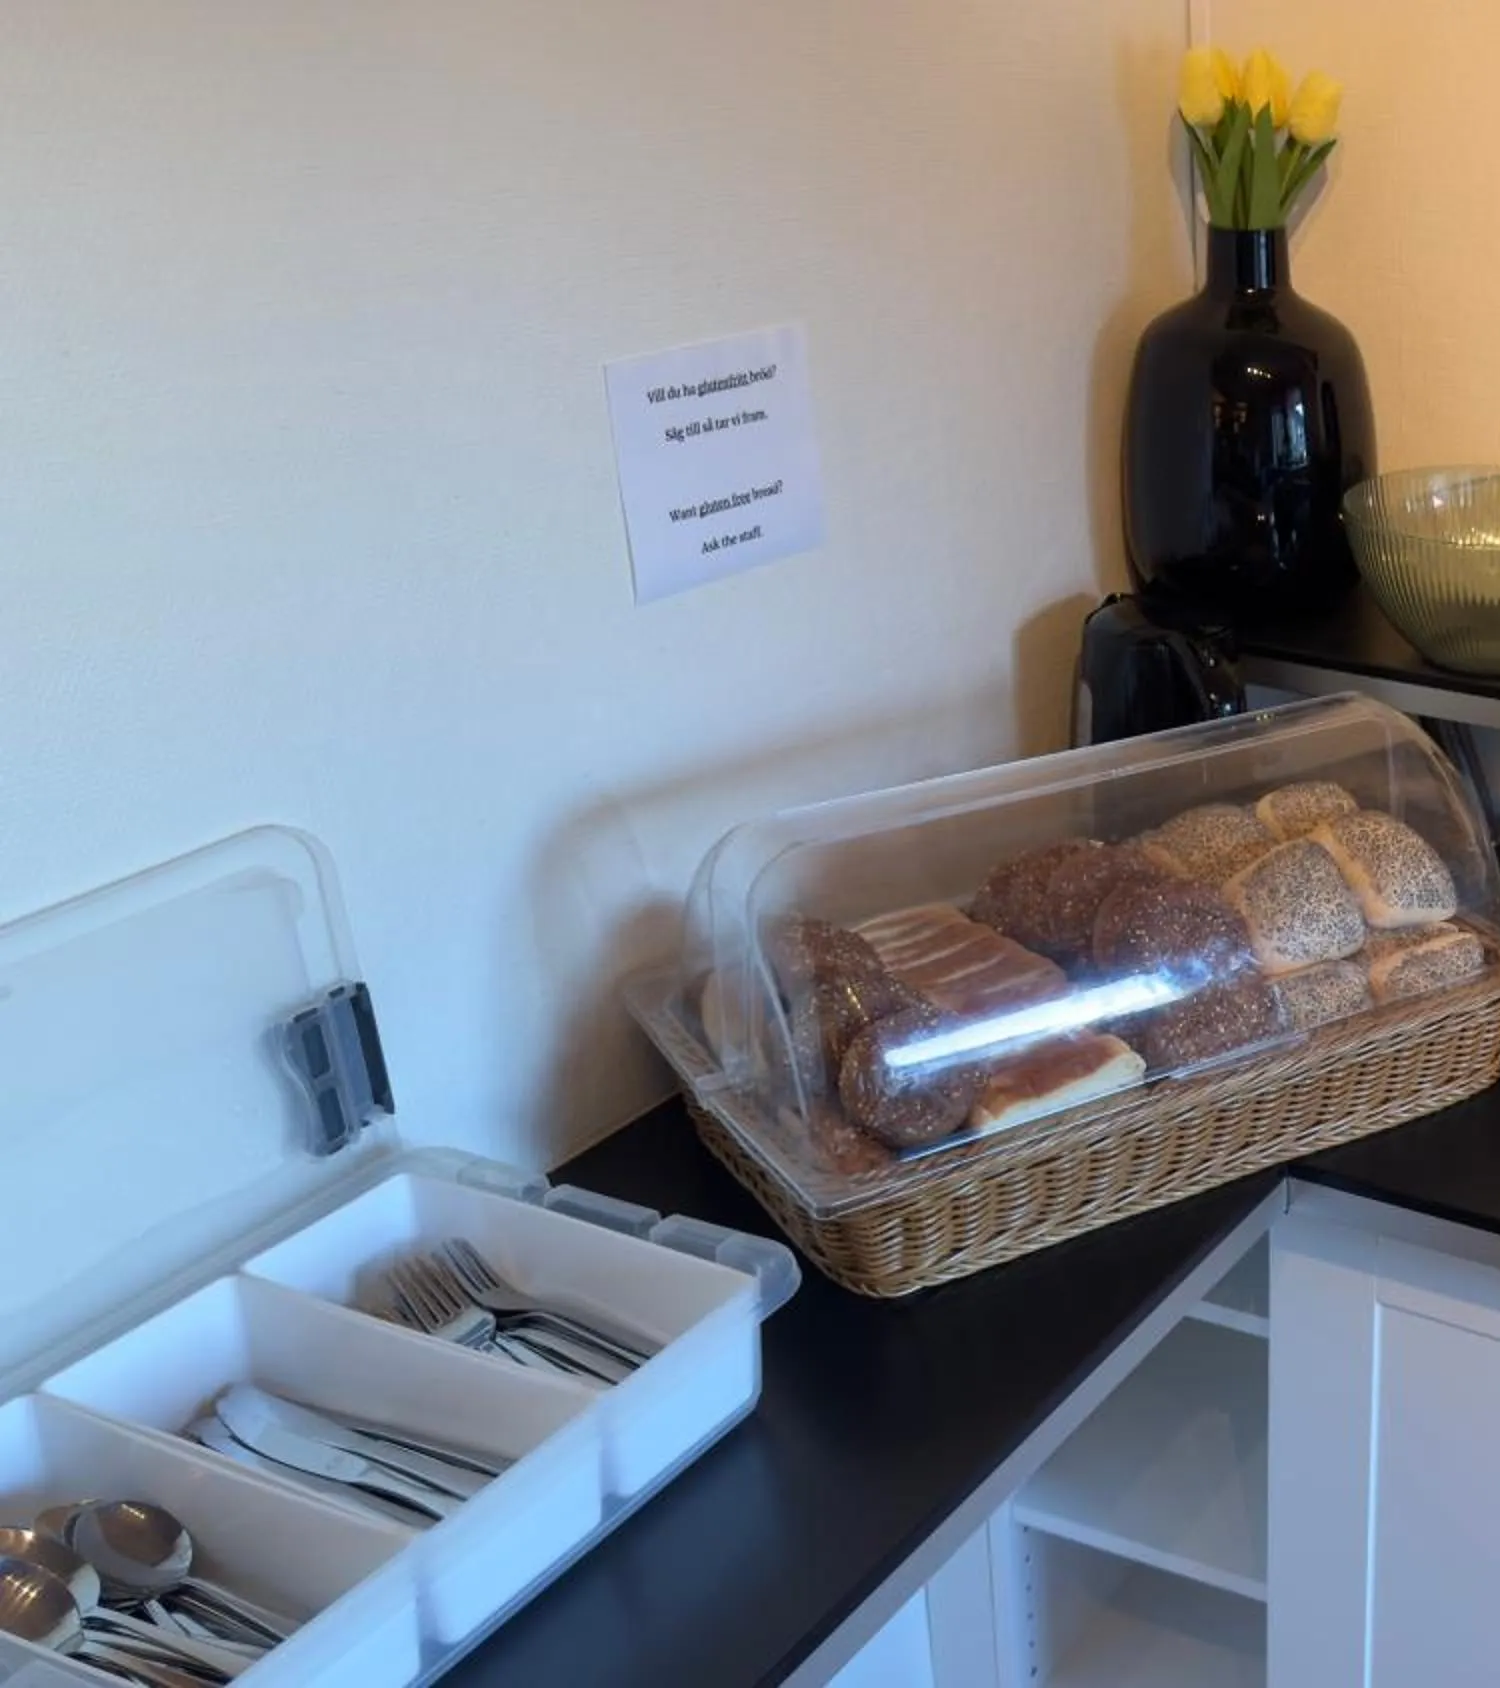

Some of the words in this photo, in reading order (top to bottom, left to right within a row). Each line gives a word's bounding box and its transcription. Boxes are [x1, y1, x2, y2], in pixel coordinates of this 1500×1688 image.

[647, 387, 666, 404] Vill
[667, 386, 681, 400] du
[682, 383, 697, 397] ha
[697, 373, 750, 397] glutenfritt
[664, 426, 685, 442] Säg
[685, 421, 701, 437] till
[702, 416, 714, 432] så
[715, 418, 729, 430] tar
[731, 413, 741, 426] vi
[741, 410, 768, 424] fram.
[669, 505, 697, 523] Want
[699, 497, 731, 518] gluten
[731, 492, 751, 508] free
[751, 479, 783, 500] bread?
[702, 537, 720, 555] Ask
[721, 535, 737, 548] the
[739, 525, 764, 543] staff.
